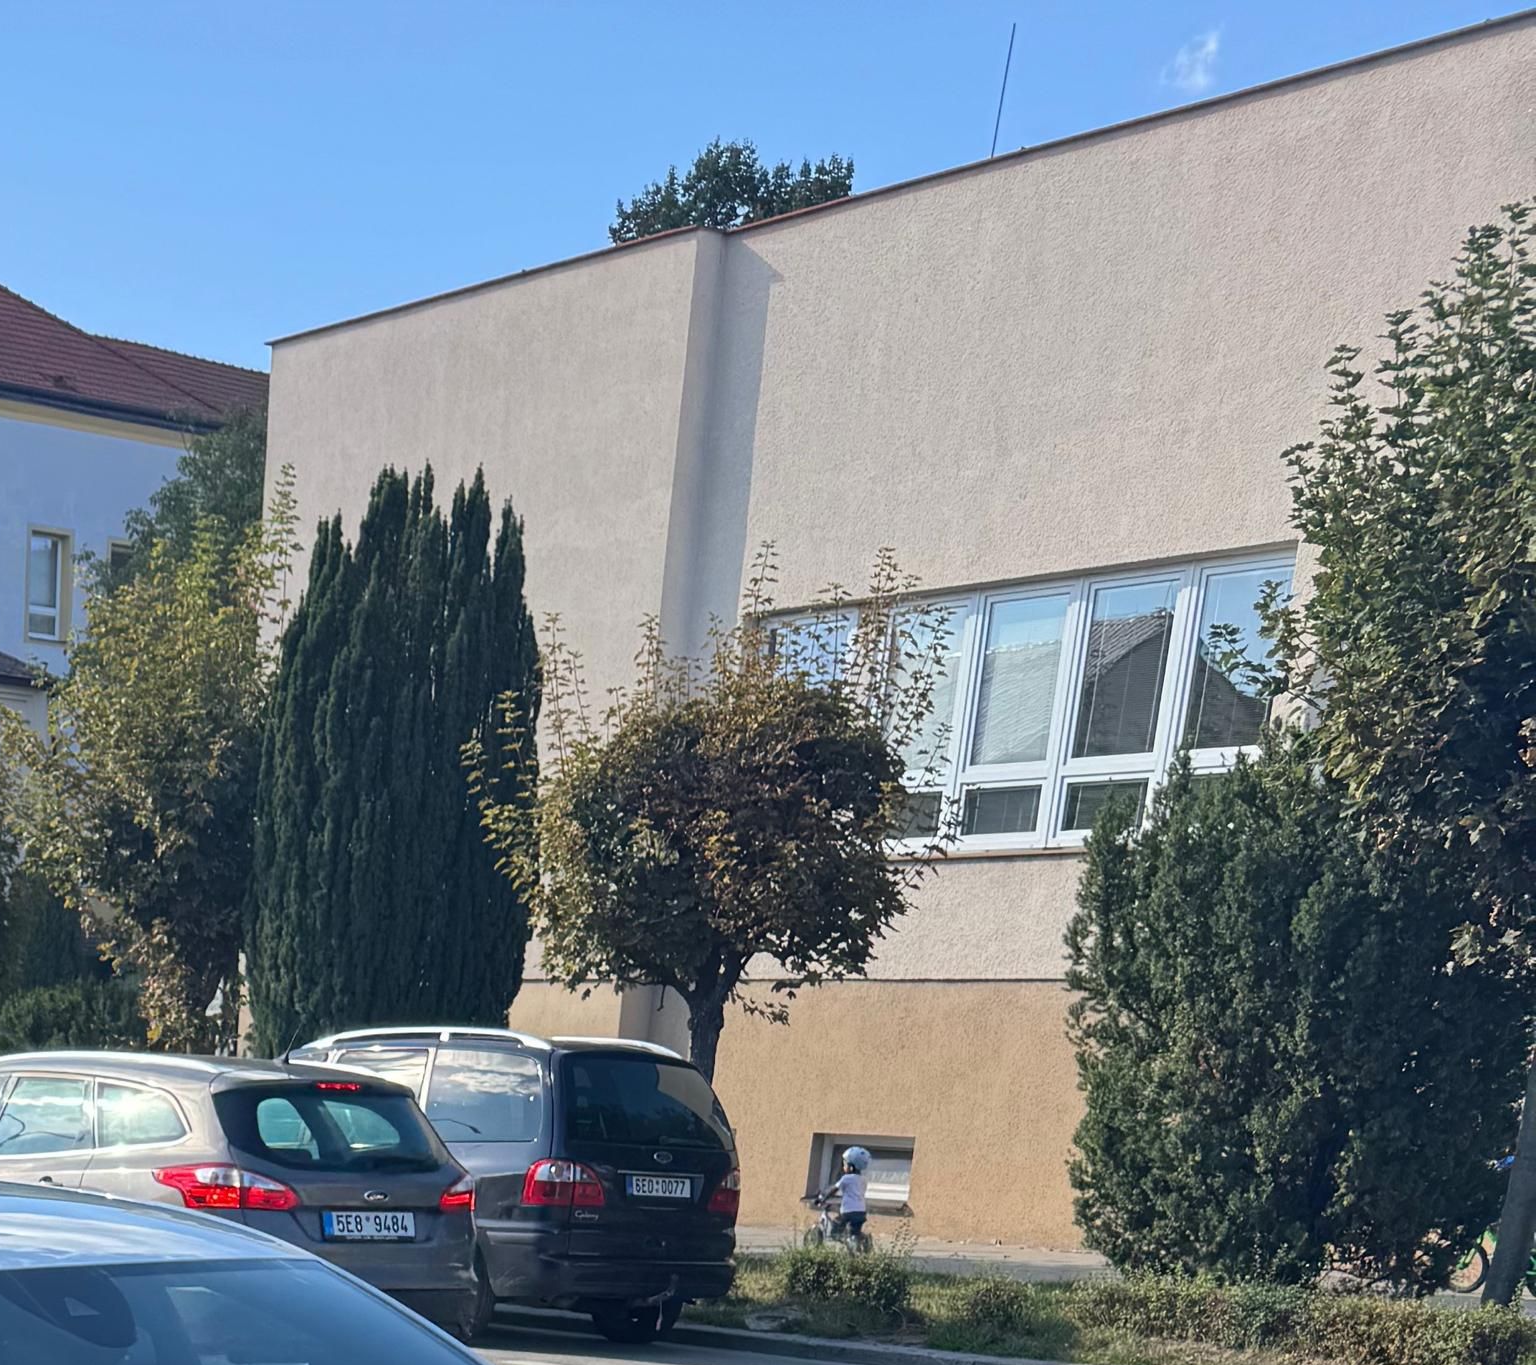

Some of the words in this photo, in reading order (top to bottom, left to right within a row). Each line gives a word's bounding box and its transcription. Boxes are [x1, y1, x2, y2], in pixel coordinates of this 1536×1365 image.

[661, 1179, 686, 1195] 0077
[336, 1214, 363, 1233] 5E8
[373, 1215, 408, 1233] 9484
